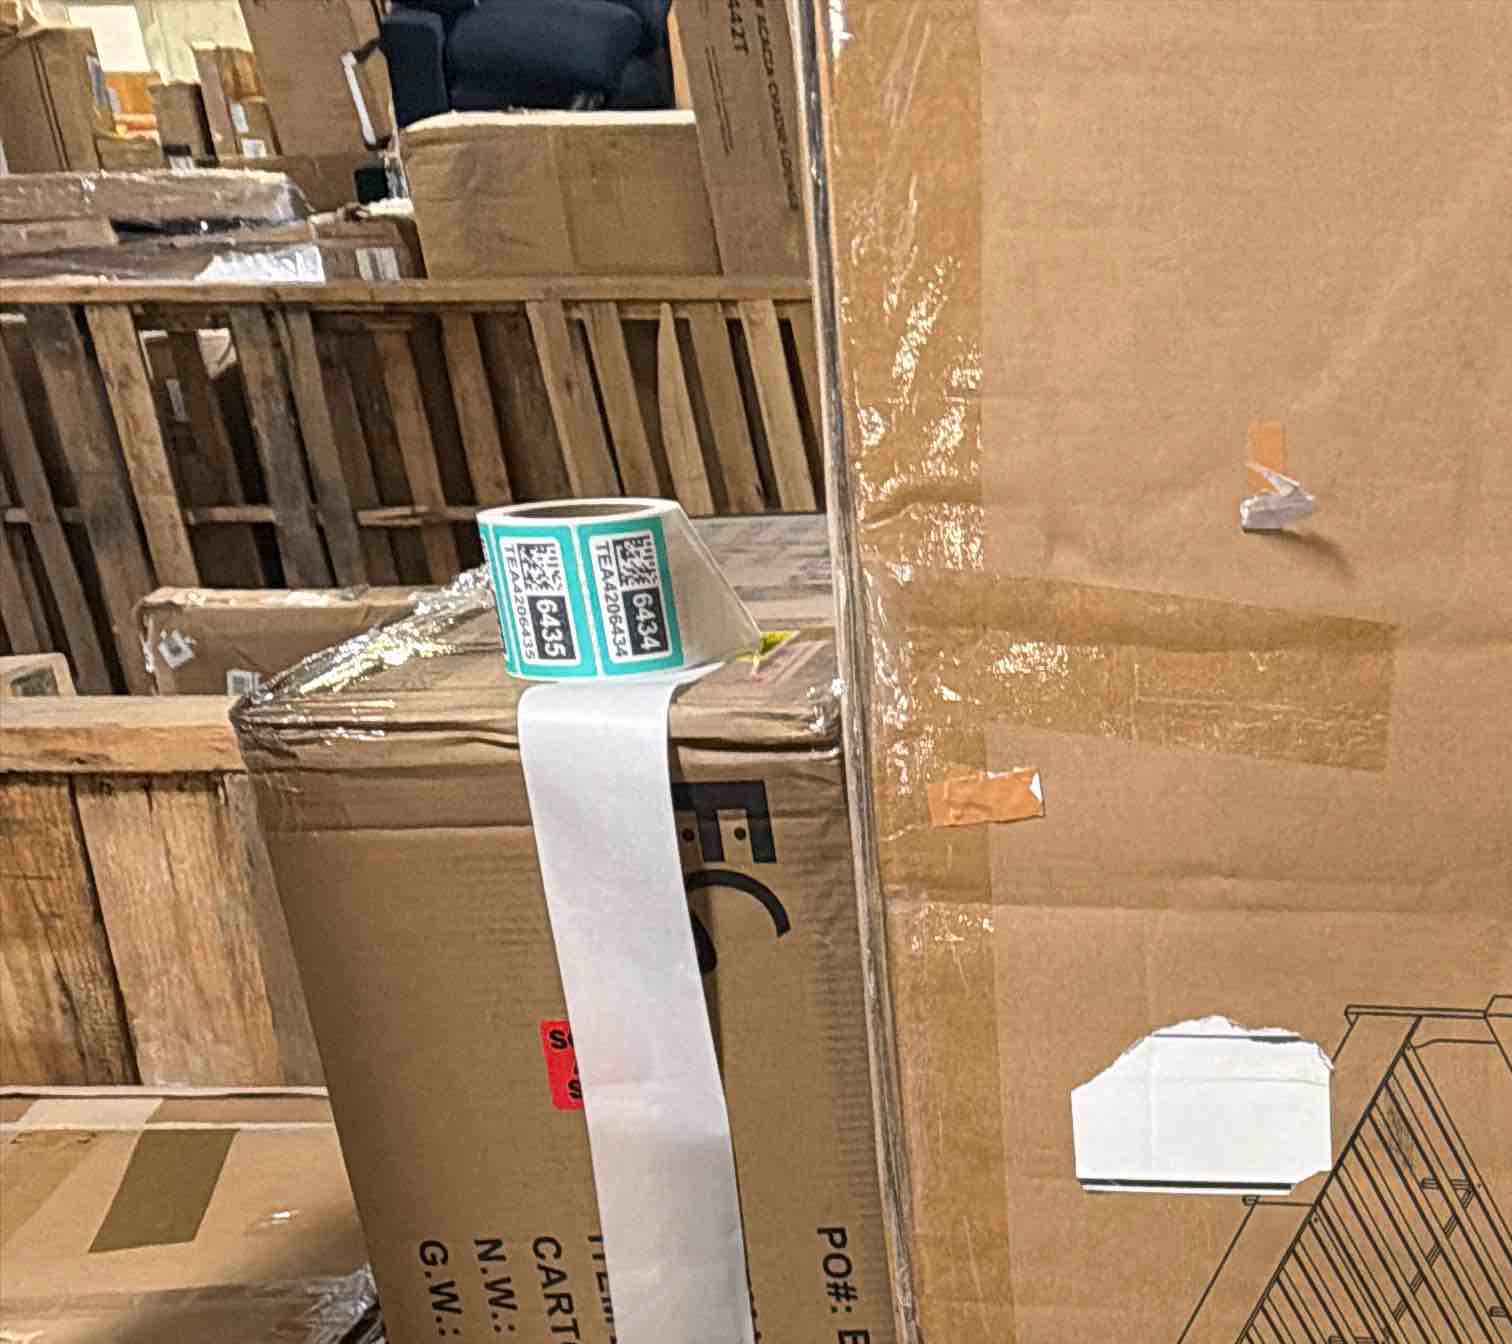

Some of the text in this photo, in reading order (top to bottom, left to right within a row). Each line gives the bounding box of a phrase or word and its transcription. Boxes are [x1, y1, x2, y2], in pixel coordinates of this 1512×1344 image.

[504, 544, 536, 660] TEA4206435
[536, 599, 567, 658] 6435
[596, 541, 629, 658] TEA4206434
[632, 592, 661, 650] 6434
[418, 1239, 462, 1338] G.W.:
[474, 1237, 516, 1333] N.W.:
[817, 1227, 859, 1314] PO#:
